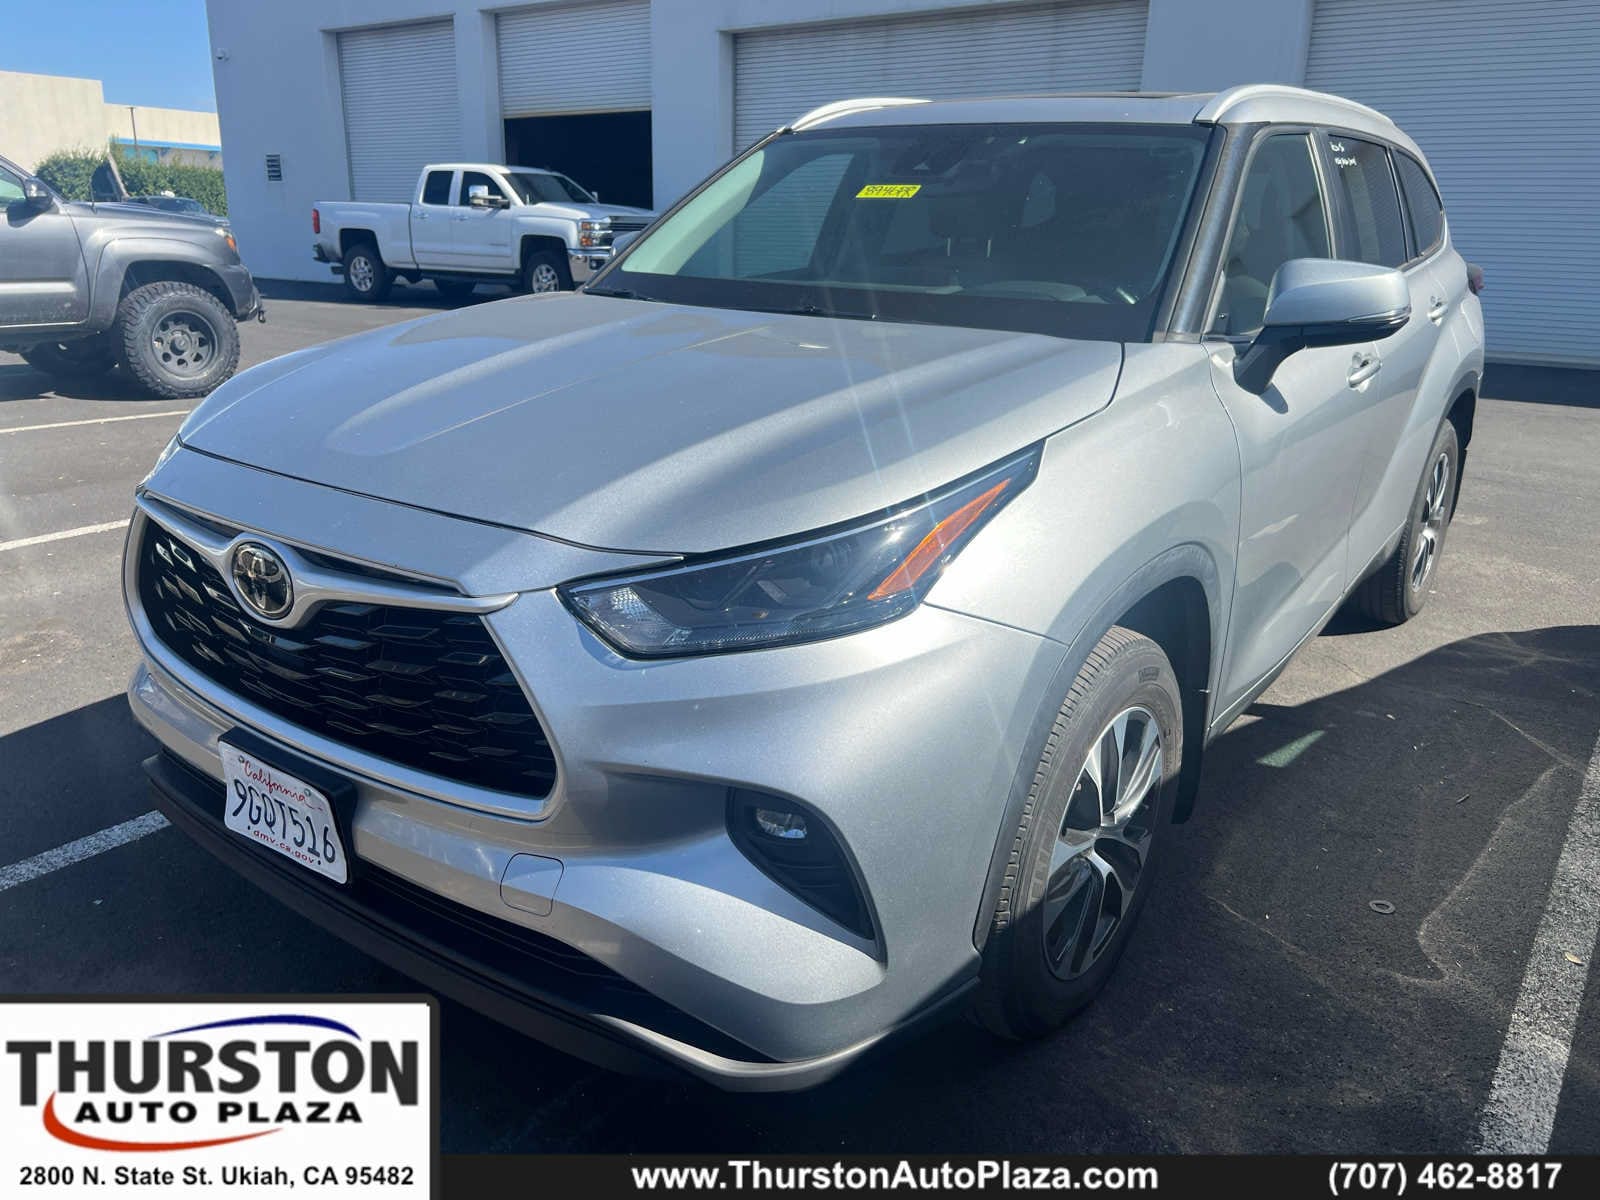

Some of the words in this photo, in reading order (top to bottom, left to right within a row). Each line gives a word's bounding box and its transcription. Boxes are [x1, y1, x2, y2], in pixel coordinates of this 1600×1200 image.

[244, 760, 312, 807] California
[232, 778, 336, 863] 9GQT516
[253, 829, 315, 864] dmv.ca.gov
